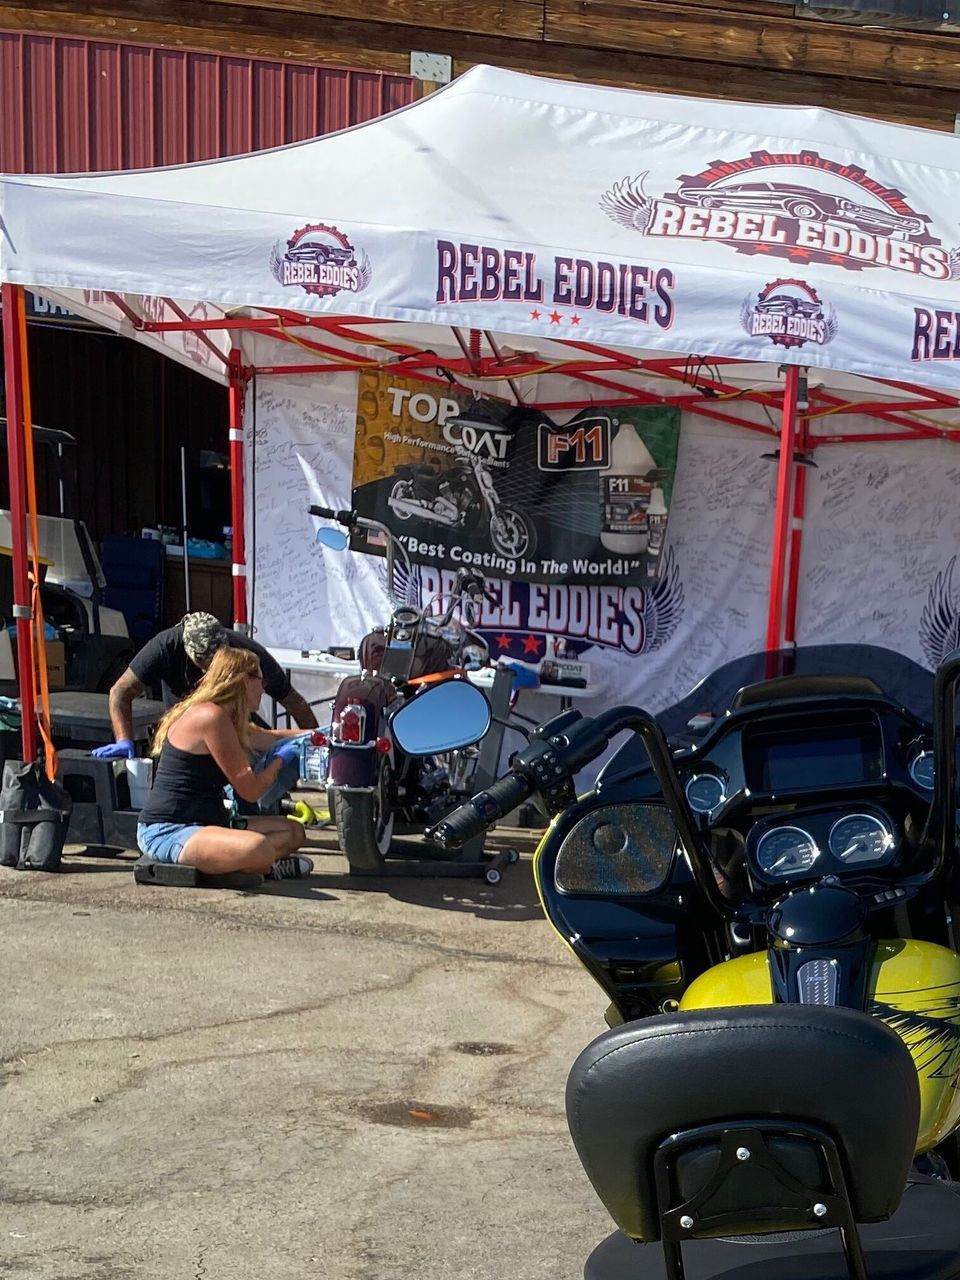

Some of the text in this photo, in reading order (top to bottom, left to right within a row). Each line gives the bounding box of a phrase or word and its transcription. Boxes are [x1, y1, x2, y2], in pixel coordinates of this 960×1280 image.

[701, 158, 758, 182] MOBILE
[761, 154, 832, 170] VEHICLE
[650, 203, 952, 280] REBEL EDDIE'S
[283, 261, 318, 285] REBEL
[436, 239, 676, 330] REBEL EDDIE'S
[751, 312, 785, 336] REBEL
[387, 386, 460, 426] TOP
[383, 431, 402, 444] High
[402, 435, 456, 455] Performance
[443, 422, 513, 459] COAT
[547, 425, 603, 464] F11
[608, 478, 629, 492] F11
[449, 546, 516, 575] Coating
[520, 558, 537, 574] In
[540, 560, 569, 575] The
[527, 581, 645, 654] EDDIE'S
